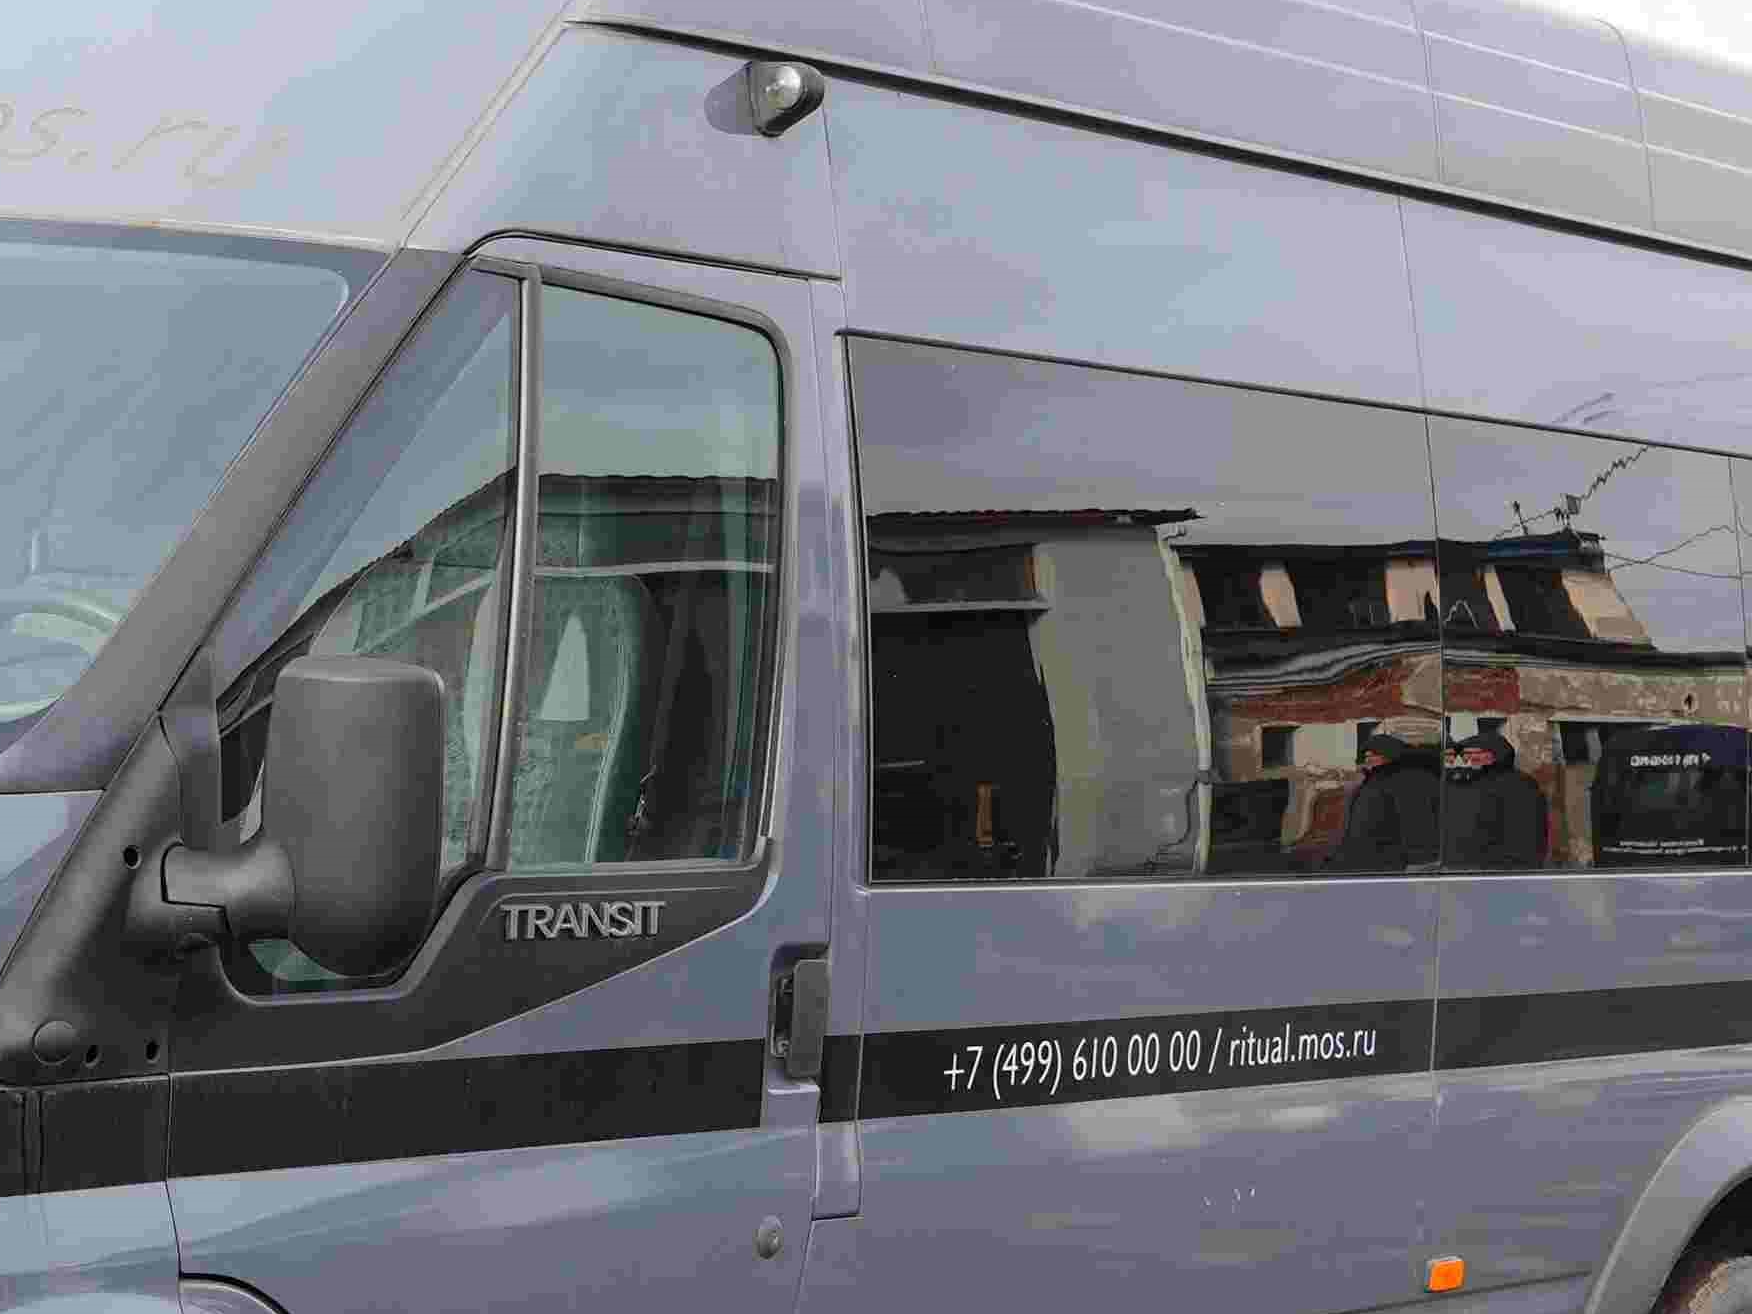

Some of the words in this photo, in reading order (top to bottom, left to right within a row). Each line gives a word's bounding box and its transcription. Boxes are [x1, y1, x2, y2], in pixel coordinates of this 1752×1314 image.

[500, 901, 667, 940] TRANSIT
[943, 1046, 984, 1090] +7
[993, 1039, 1063, 1100] (499)
[1072, 1036, 1118, 1082] 610
[1127, 1032, 1161, 1076] 00
[1169, 1029, 1202, 1072] 00
[1229, 1023, 1377, 1067] ritual.mos.ru
